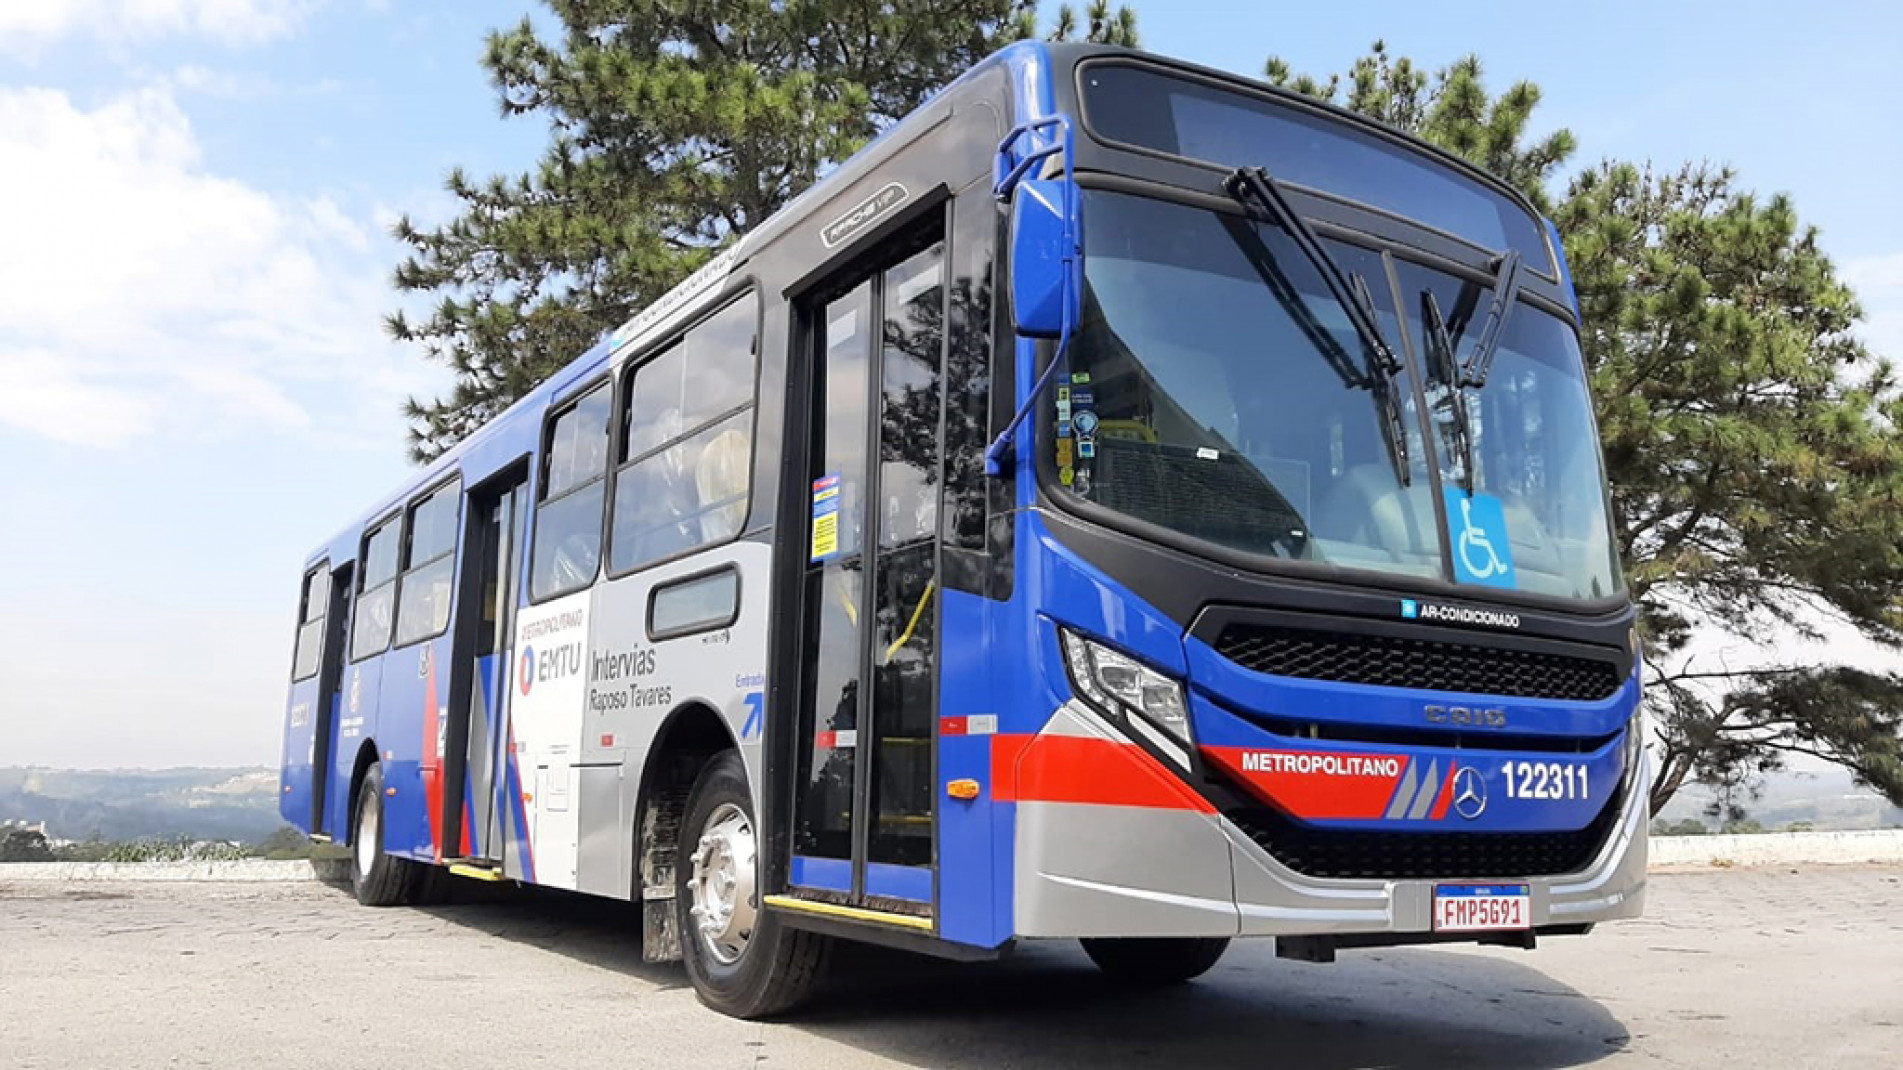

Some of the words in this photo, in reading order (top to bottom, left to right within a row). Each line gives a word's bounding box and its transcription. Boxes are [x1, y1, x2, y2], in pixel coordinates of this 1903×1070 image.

[538, 642, 582, 682] EMTU
[591, 643, 656, 682] Intervias
[589, 687, 627, 716] Raposo
[629, 683, 672, 708] Tavares
[1241, 752, 1399, 777] METROPOLITANO
[1501, 761, 1589, 800] 122311
[1444, 898, 1521, 926] FMP5G91
